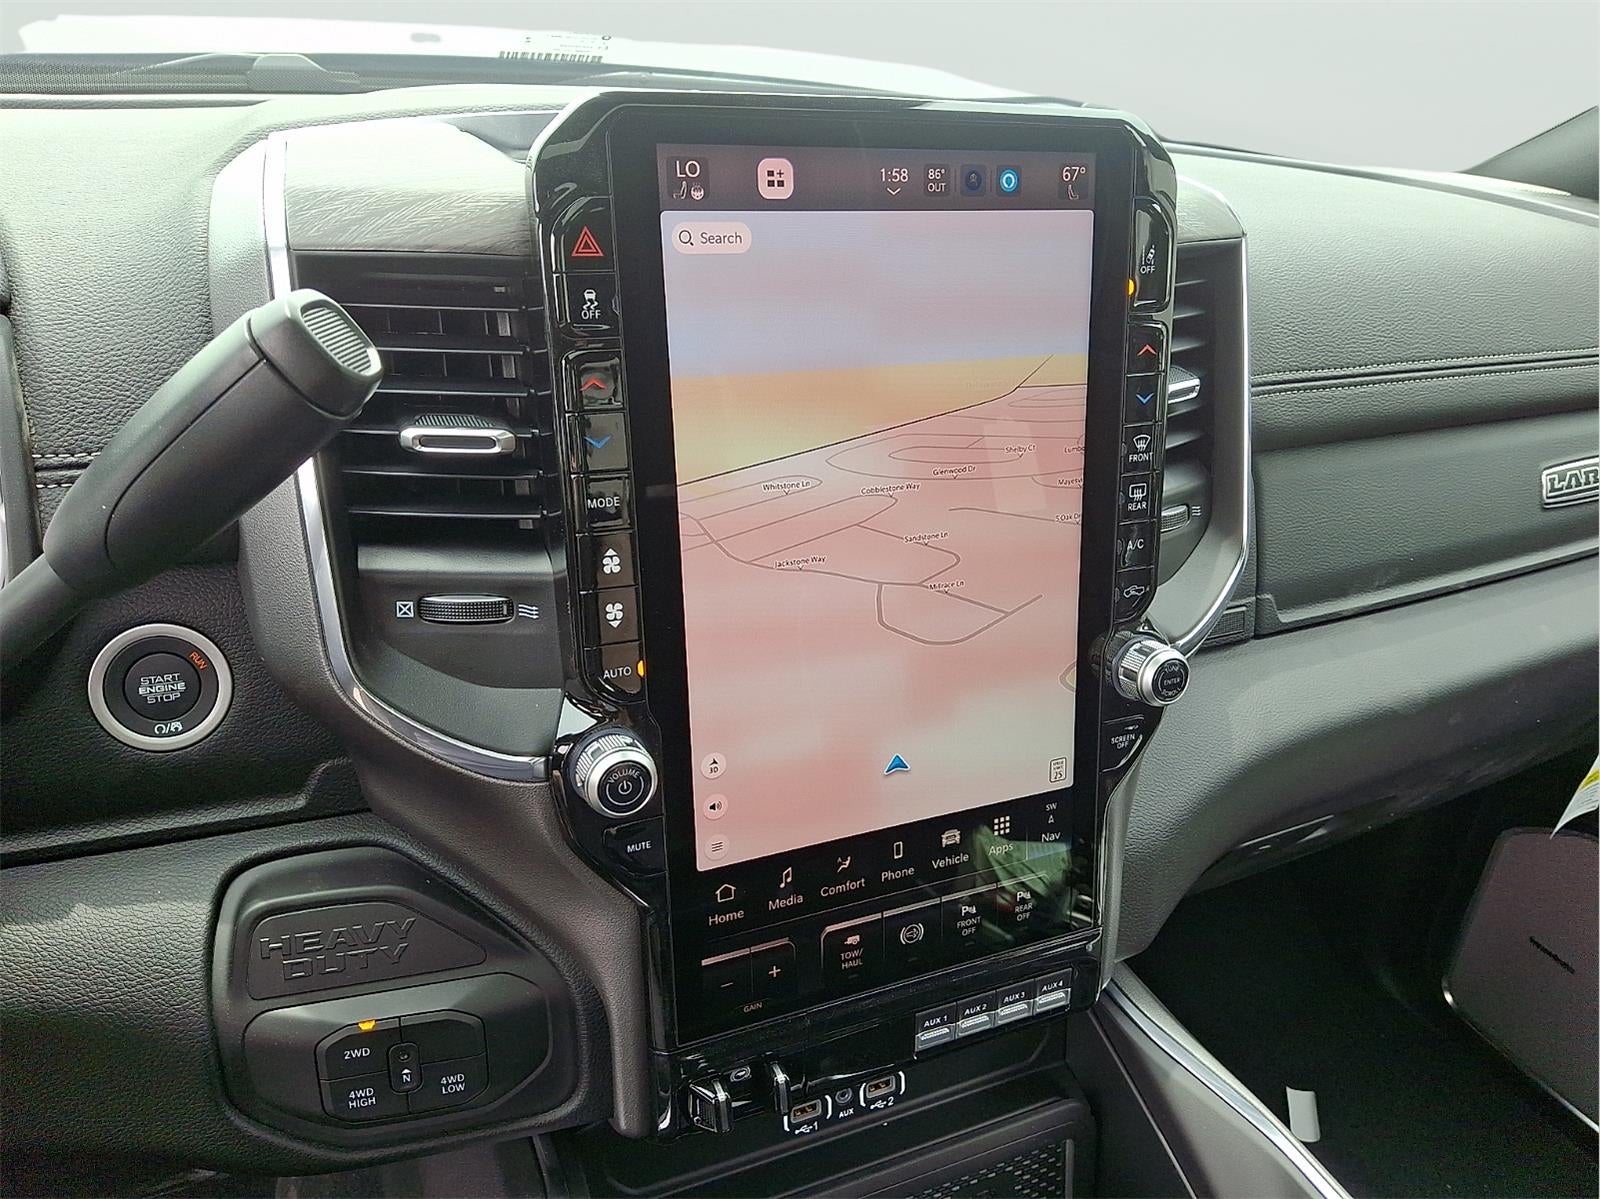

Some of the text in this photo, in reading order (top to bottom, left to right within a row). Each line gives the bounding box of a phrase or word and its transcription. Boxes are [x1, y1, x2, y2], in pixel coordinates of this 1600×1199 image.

[675, 160, 700, 178] LO
[880, 168, 909, 183] 1:58
[927, 182, 947, 193] OUT
[700, 231, 743, 245] Search
[1140, 265, 1156, 274] OFF
[581, 309, 601, 320] OFF
[1005, 444, 1036, 454] Shelby Ct
[1129, 452, 1154, 463] FRONT
[933, 464, 976, 476] Glenwood Dr
[763, 480, 811, 492] Whitstone Ln
[861, 482, 921, 495] Cobblestone Way
[587, 496, 621, 510] MODE
[1128, 501, 1147, 511] REAR
[904, 530, 949, 543] Sandstone Ln
[1127, 539, 1145, 550] A/C
[775, 555, 826, 569] Jackstone Way
[189, 651, 208, 671] RUN
[140, 673, 181, 685] START
[603, 666, 632, 680] AUTO
[1163, 677, 1181, 686] ENTER
[138, 682, 187, 695] ENGINE
[147, 692, 181, 704] STOP
[1110, 733, 1136, 744] SCREEN
[1116, 742, 1129, 750] OFF
[608, 768, 641, 784] VOLUME
[709, 766, 719, 774] 3D
[1045, 802, 1058, 811] SW
[627, 840, 652, 853] MUTE
[708, 832, 1061, 927] Home Media Comfort Phone Vehicle Apps Nav
[1014, 902, 1033, 913] REAR
[957, 916, 981, 929] FRONT
[1016, 912, 1031, 922] OFF
[961, 926, 977, 937] OFF
[259, 918, 416, 960] HEAVY
[840, 947, 863, 960] TOW/
[282, 943, 408, 981] DUTY
[841, 959, 863, 970] HAUL
[1042, 982, 1058, 992] AUX
[1003, 993, 1019, 1003] AUX
[743, 1001, 763, 1013] GAIN
[965, 1005, 981, 1016] AUX
[924, 1017, 942, 1028] AUX
[344, 1047, 371, 1060] 2WD
[402, 1073, 411, 1083] N
[441, 1073, 465, 1086] 4WD
[349, 1087, 375, 1100] 4WD
[442, 1083, 466, 1095] LOW
[348, 1097, 377, 1109] HIGH
[887, 1097, 894, 1106] 2
[838, 1108, 854, 1119] AUX
